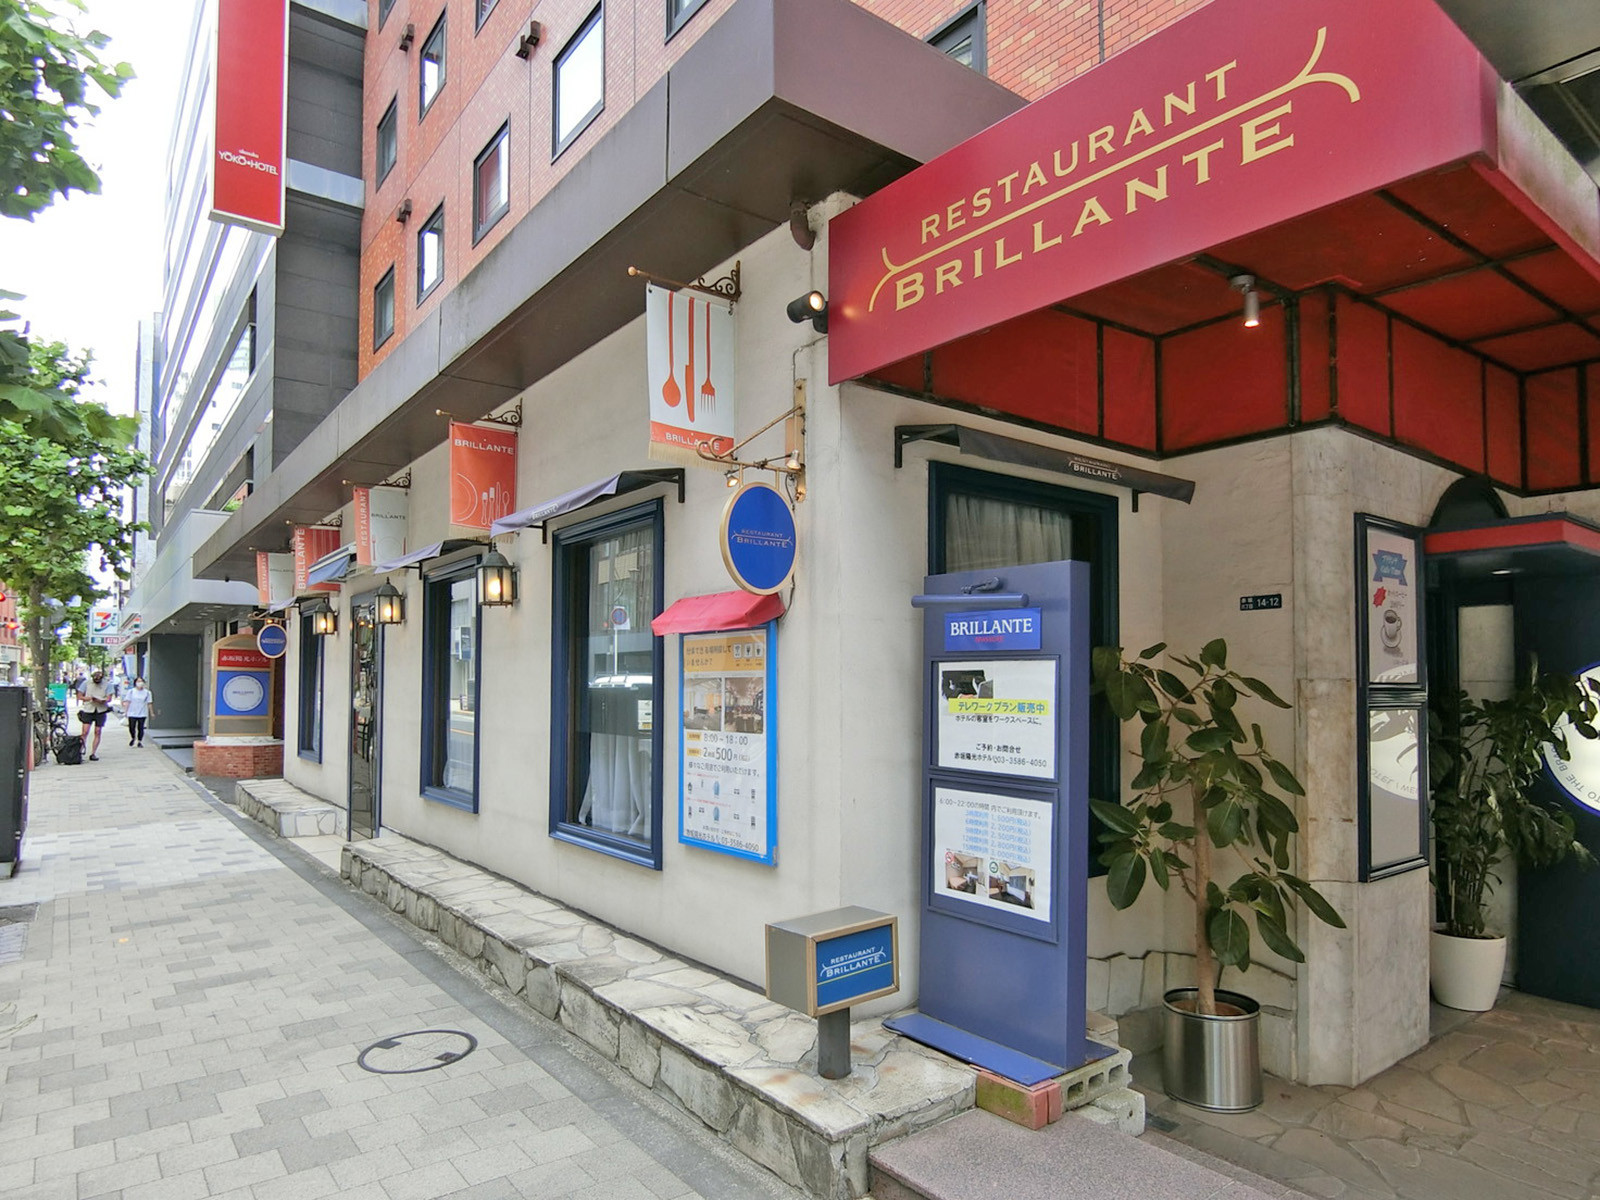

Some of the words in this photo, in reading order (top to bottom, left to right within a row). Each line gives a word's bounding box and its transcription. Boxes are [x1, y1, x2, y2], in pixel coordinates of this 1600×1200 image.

[920, 60, 1237, 244] RESTAURANT
[895, 100, 1295, 311] BRILLANTE
[454, 438, 514, 455] BRILLANTE
[665, 432, 720, 451] BRILLAE
[1073, 463, 1118, 480] BRILLANTE
[360, 491, 368, 547] RESTAURANT
[736, 536, 788, 548] BRILLANTE
[741, 528, 784, 538] RESTAURANT
[297, 528, 305, 590] BRILLANTE
[1257, 598, 1279, 607] 14-12
[950, 618, 1033, 636] BRILLANTE
[996, 756, 1047, 768] 03-3586-4050
[1566, 774, 1584, 792] THE
[830, 946, 876, 964] RESTAURANT
[826, 954, 880, 978] BRILLANTE
